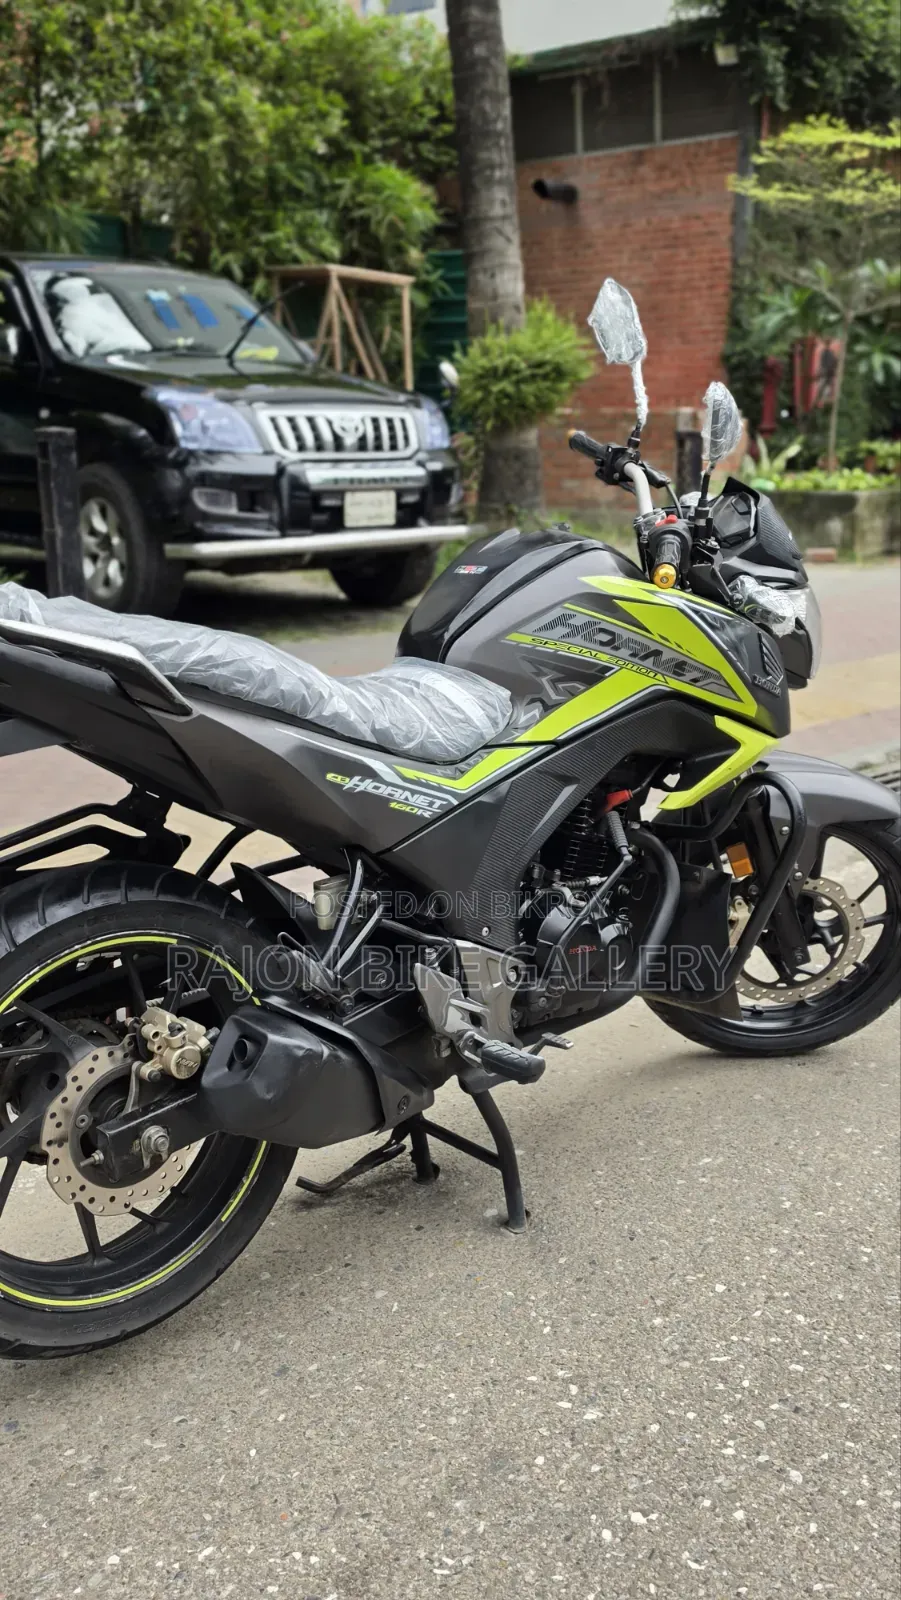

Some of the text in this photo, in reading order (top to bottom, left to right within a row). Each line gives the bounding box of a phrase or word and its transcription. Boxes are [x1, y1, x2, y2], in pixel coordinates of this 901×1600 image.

[531, 612, 723, 683] HORNET
[531, 637, 659, 679] SPECIAL EDITION
[342, 775, 448, 808] HORNET
[388, 801, 433, 818] 160R
